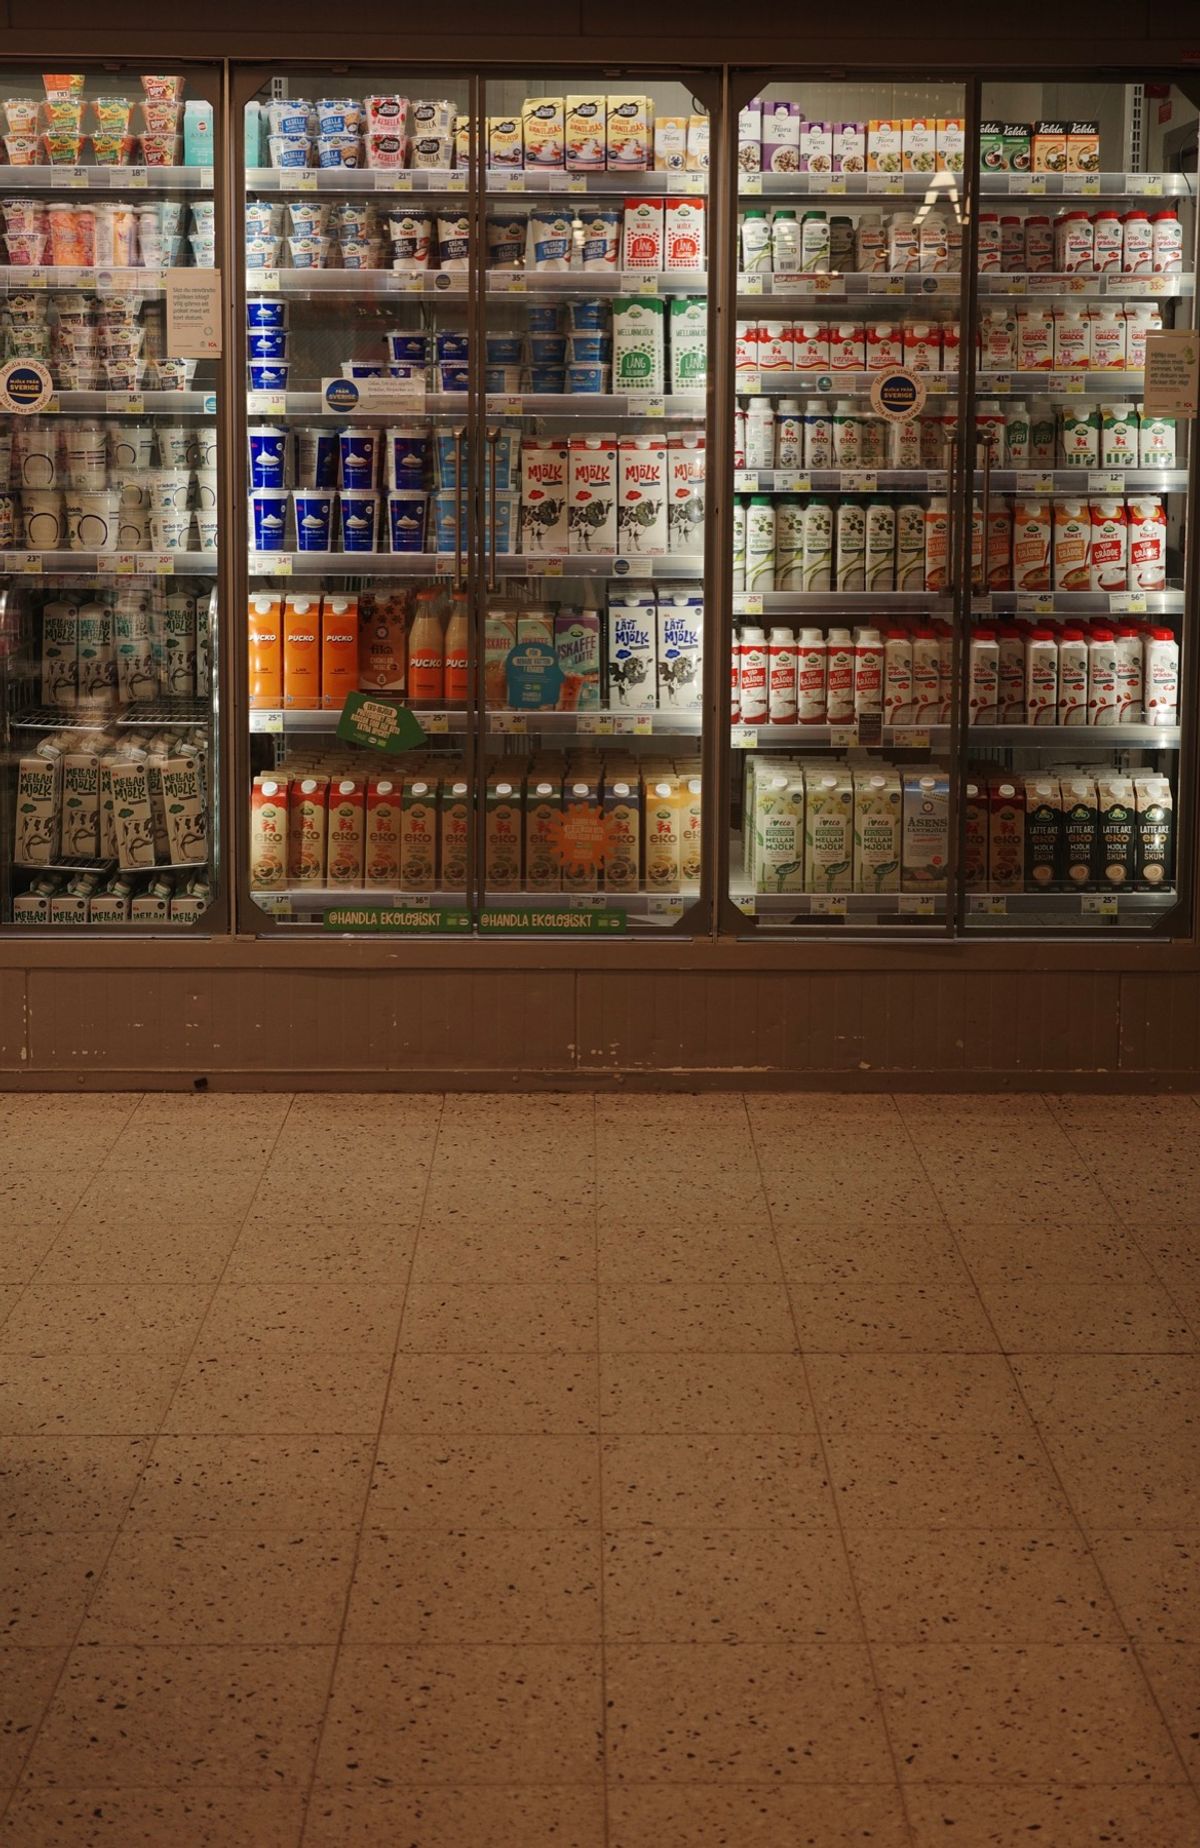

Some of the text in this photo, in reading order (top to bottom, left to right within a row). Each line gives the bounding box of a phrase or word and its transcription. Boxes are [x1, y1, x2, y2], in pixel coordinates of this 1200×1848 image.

[1003, 126, 1028, 136] Kelda
[1039, 123, 1064, 134] Kelda
[1072, 123, 1096, 134] Kelda
[1009, 434, 1026, 444] FRI
[528, 464, 562, 482] MJÖLK
[575, 464, 610, 483] MJÖLK
[626, 464, 660, 482] MJÖLK
[616, 618, 636, 632] LÄTT
[664, 618, 684, 632] LÄTT
[616, 630, 648, 646] MJÖLK
[664, 630, 698, 646] MJÖLK
[410, 658, 442, 667] PUCKO
[907, 816, 947, 827] ÅSENS
[332, 831, 359, 841] eko
[370, 832, 397, 842] eko
[404, 833, 431, 842] eko
[650, 834, 677, 843] eko
[15, 911, 46, 922] MELLAN
[53, 912, 84, 922] MELLAN
[92, 912, 124, 922] MELLAN
[329, 912, 377, 925] @HANDLA
[481, 914, 528, 927] @HANDLA
